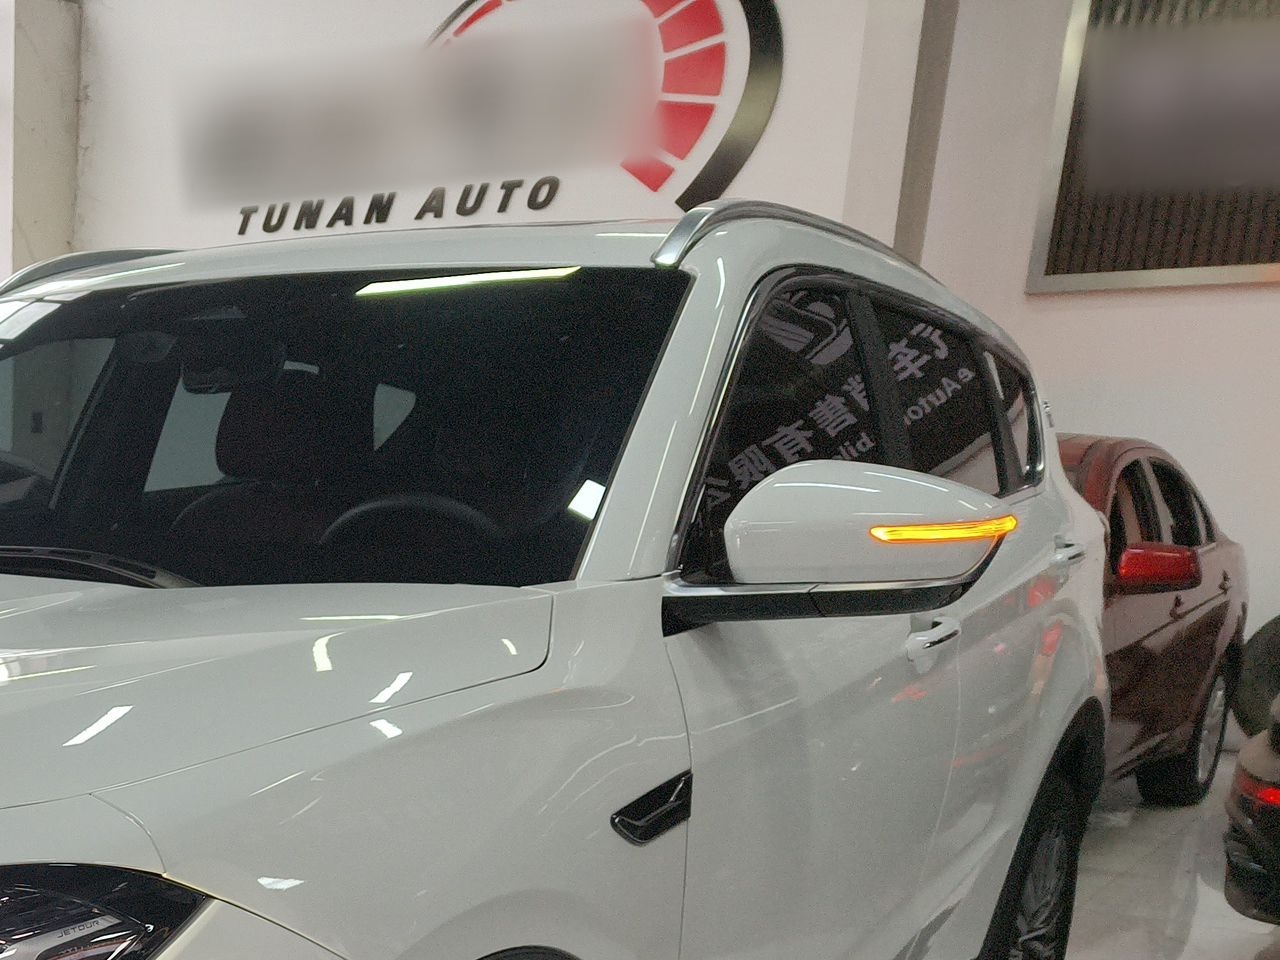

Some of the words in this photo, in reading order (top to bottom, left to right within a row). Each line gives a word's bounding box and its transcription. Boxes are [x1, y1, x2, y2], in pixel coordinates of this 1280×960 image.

[237, 191, 397, 236] TUNAN
[415, 176, 560, 222] AUTO
[57, 920, 100, 938] JETOUR
